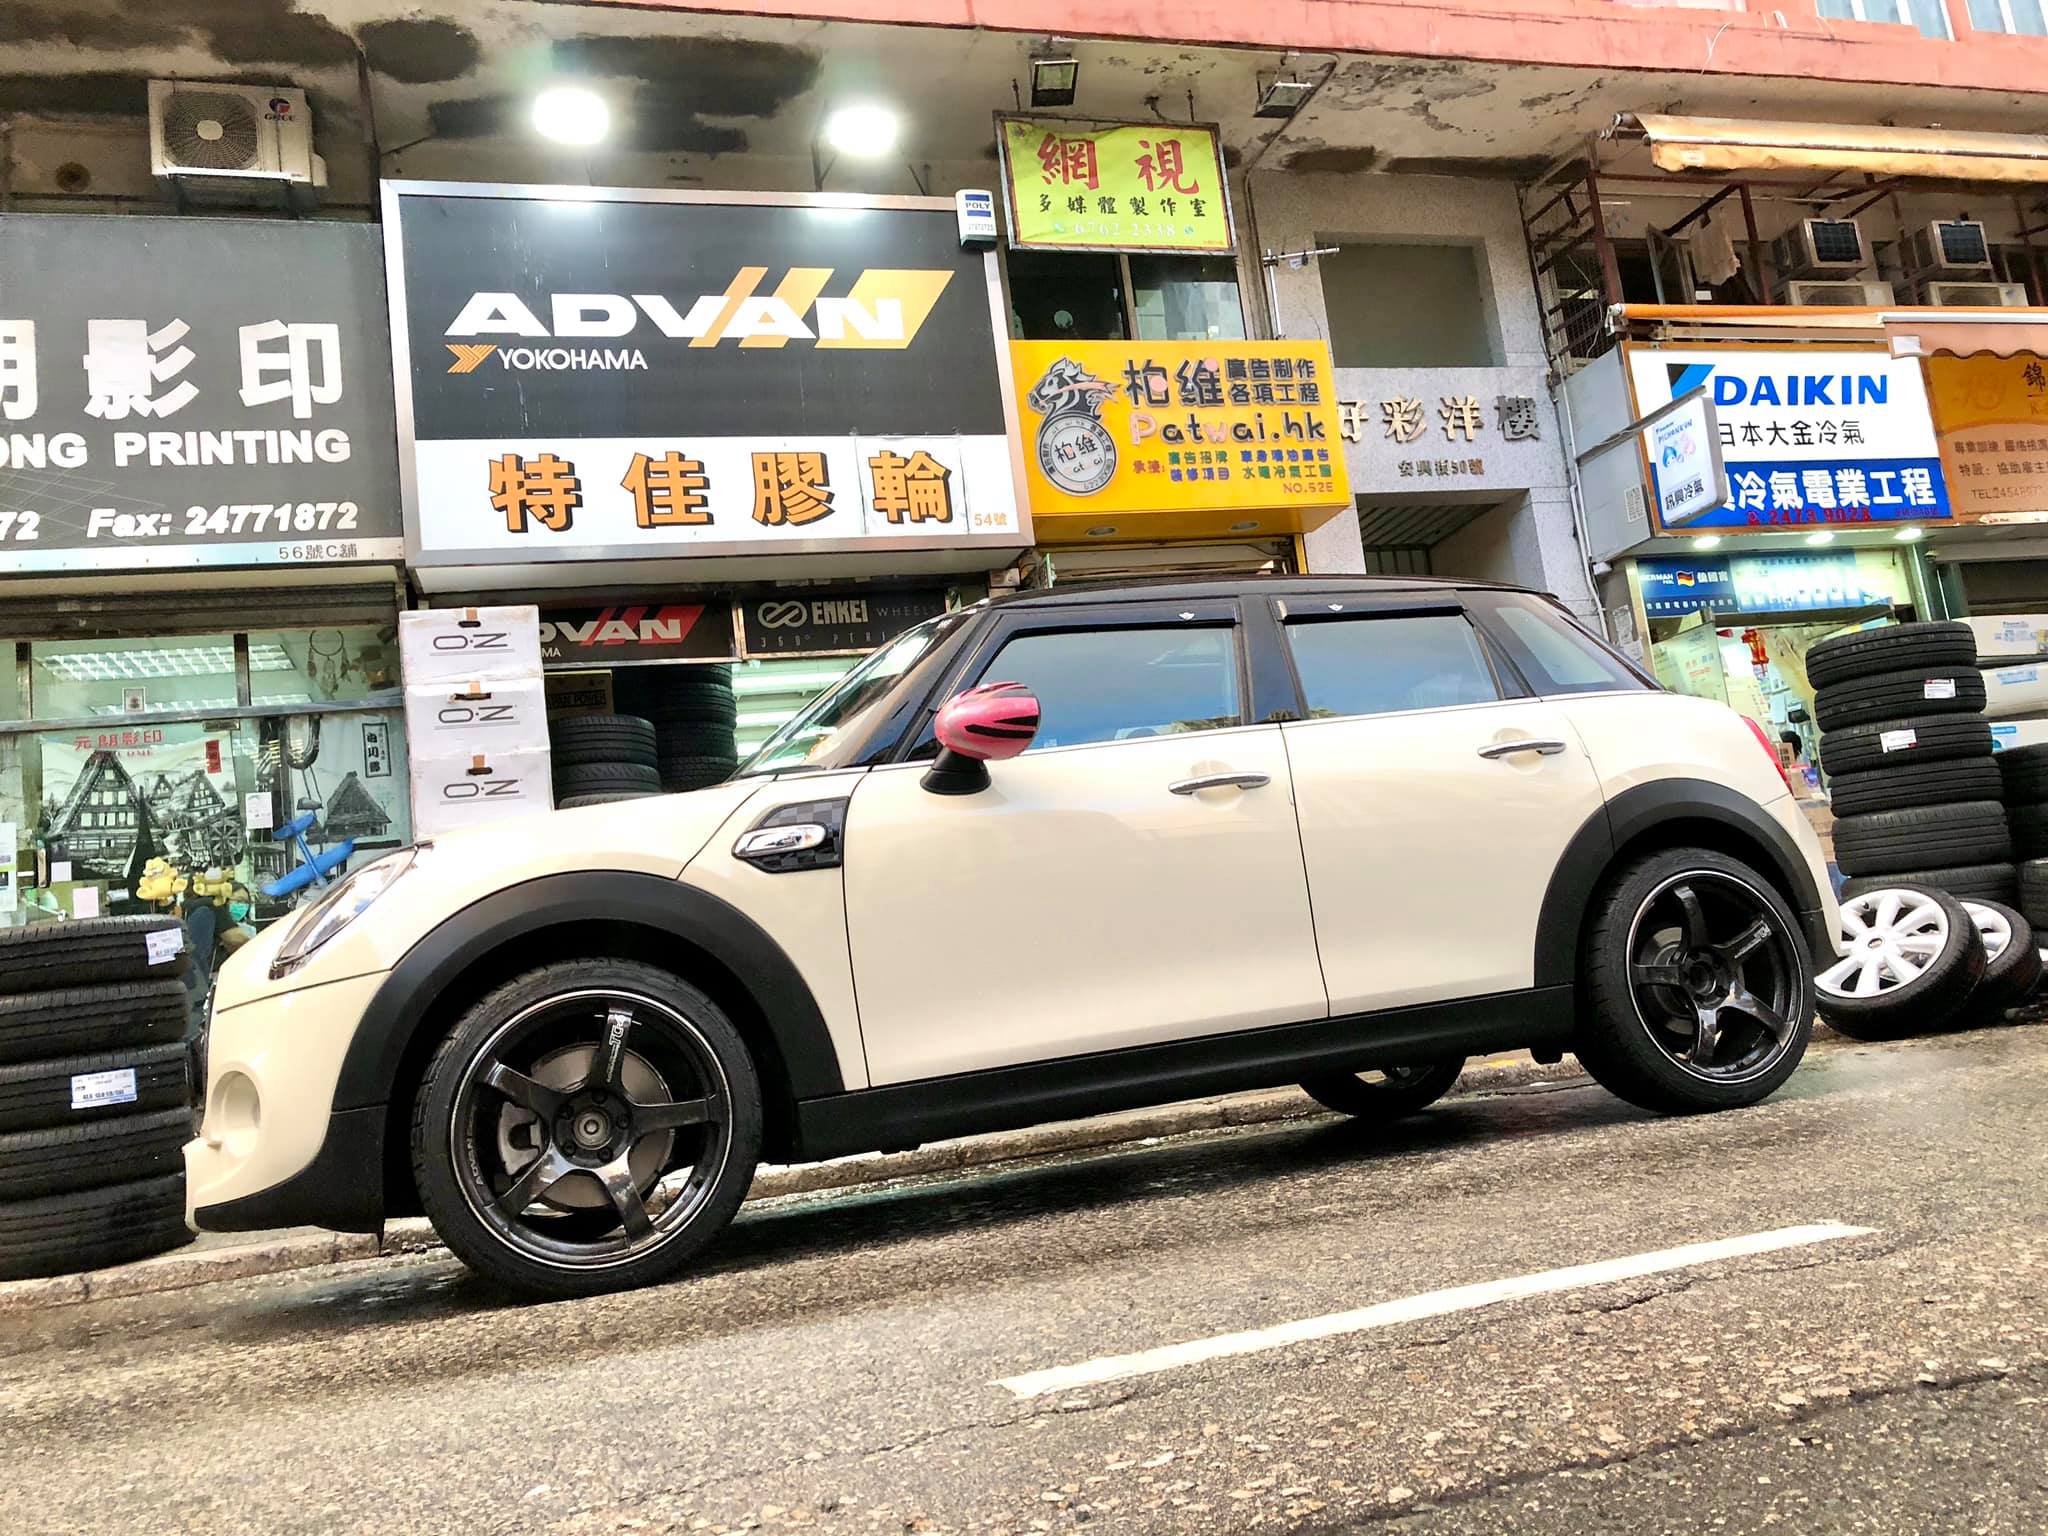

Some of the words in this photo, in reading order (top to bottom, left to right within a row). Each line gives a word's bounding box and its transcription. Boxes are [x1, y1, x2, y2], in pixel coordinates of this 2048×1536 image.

[1037, 132, 1199, 195] 網視
[1039, 193, 1206, 217] 多媒體製作室
[1131, 222, 1175, 236] 2338
[444, 291, 905, 341] ADVAN
[498, 348, 648, 370] YOKOHAMA
[1225, 358, 1315, 381] 廣告制作
[1230, 382, 1320, 405] 各項工程
[1715, 374, 1888, 406] DAIKIN
[1129, 411, 1326, 445] Patwai.hk
[1719, 419, 1864, 447] 日本大金冷氣
[114, 428, 351, 467] PRINTING
[487, 449, 954, 534] 特佳膠輪
[87, 508, 172, 538] Fax:
[184, 502, 358, 535] 24771872
[973, 512, 1008, 527] 54號
[811, 600, 869, 625] ENKEI
[876, 605, 938, 617] WHEELS
